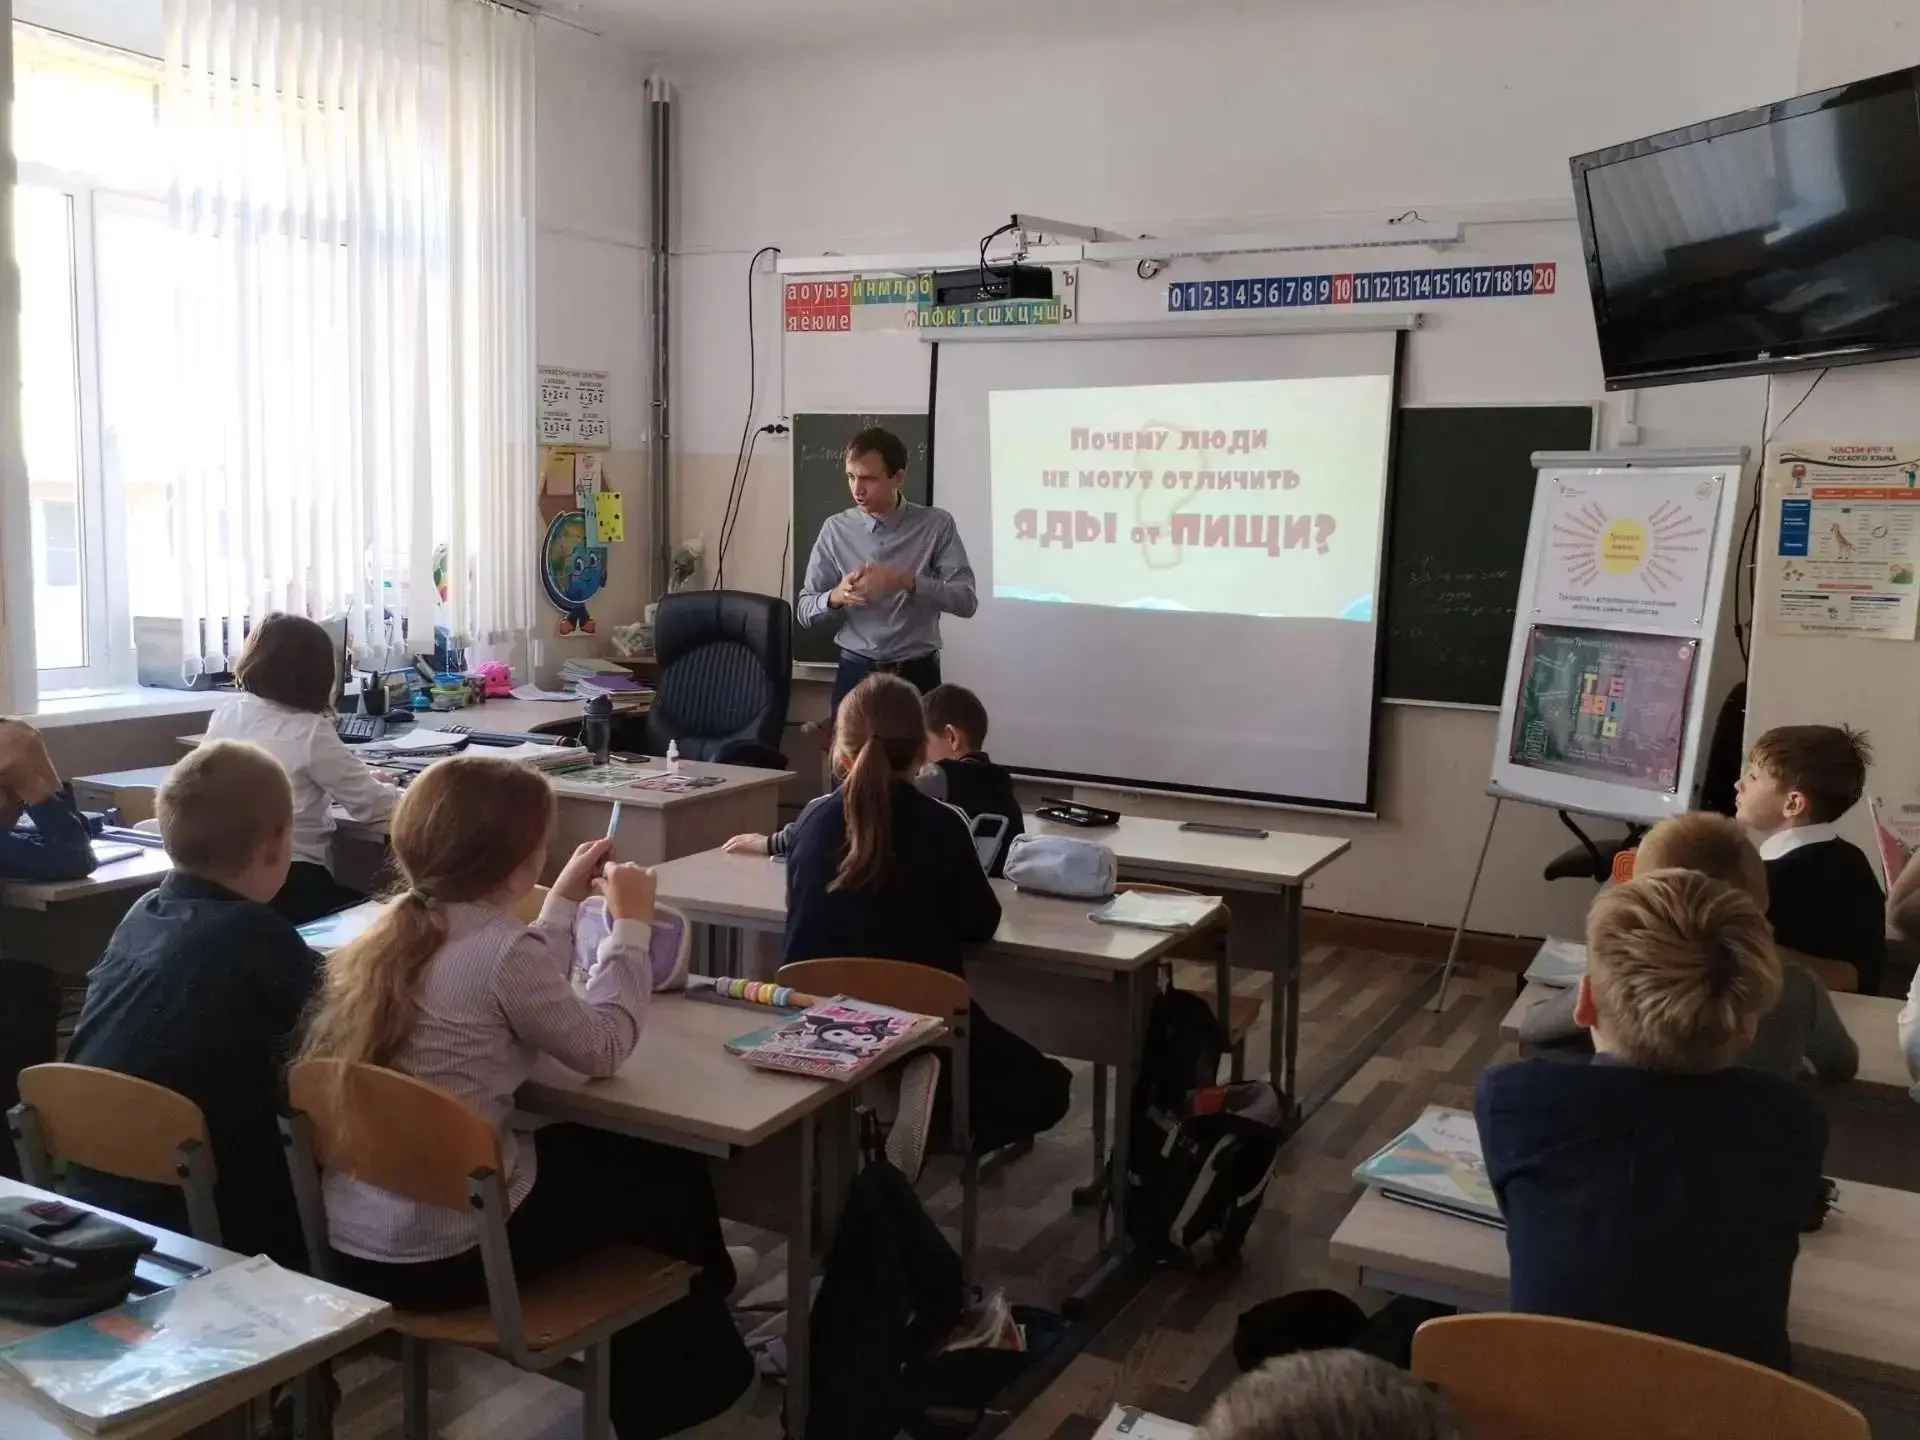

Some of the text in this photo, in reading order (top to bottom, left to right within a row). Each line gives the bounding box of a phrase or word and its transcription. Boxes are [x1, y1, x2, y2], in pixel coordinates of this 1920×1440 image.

[1172, 268, 1554, 307] 0 1 2 3 4 5 6 7 8 9 10 11 12 13 14 15 16 17 18 19 20
[1070, 427, 1268, 454] ПОЧЕМУ ЛЮДИ
[1042, 469, 1302, 490] НЕ МОГУТ ОТЛИЧИТЬ
[1013, 508, 1337, 557] ЯДЫ ОТ ПИЩИ?
